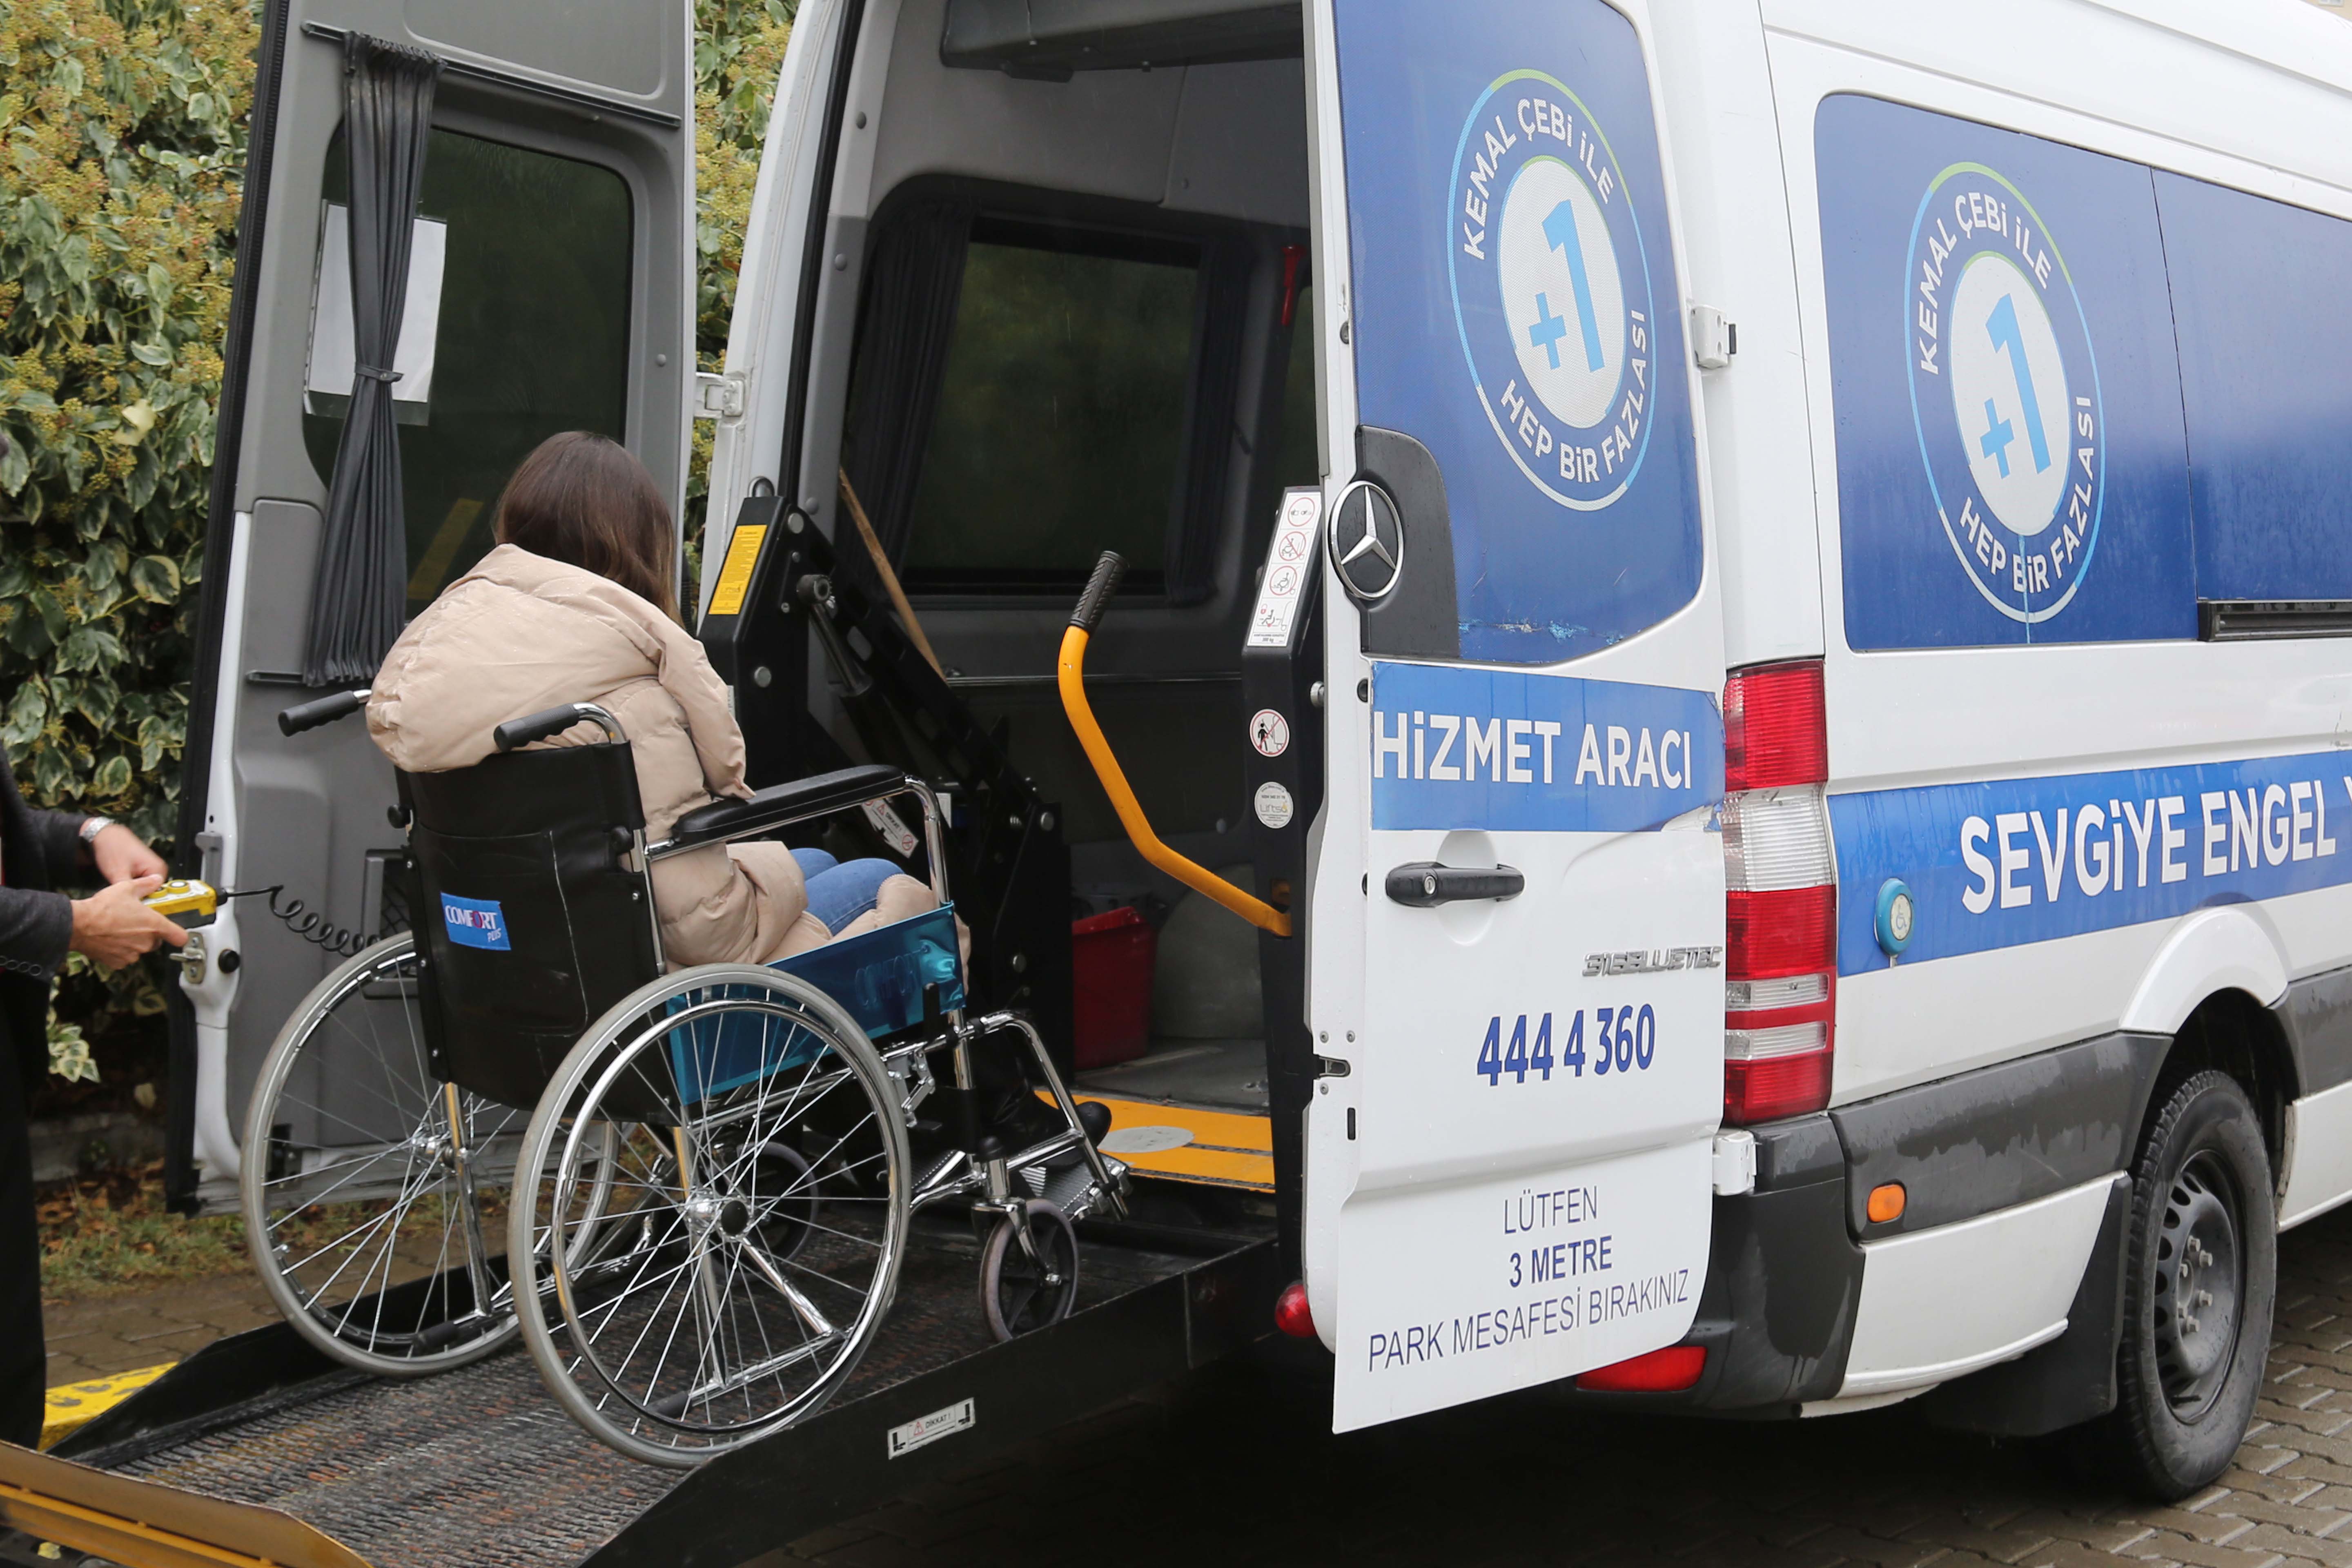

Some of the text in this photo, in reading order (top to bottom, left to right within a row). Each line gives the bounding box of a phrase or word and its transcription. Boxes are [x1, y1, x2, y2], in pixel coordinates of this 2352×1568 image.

[1464, 115, 1517, 260] KEMAL
[1919, 218, 1957, 375] KEMAL
[1501, 379, 1552, 458] HEP
[1601, 310, 1646, 475] FAZLASI
[1960, 497, 2006, 575] HEP
[2050, 396, 2094, 579] FAZLASI
[1575, 724, 1691, 789] ARACI
[2200, 779, 2336, 877] ENGEL
[445, 905, 498, 929] COMFORT
[1477, 1003, 1655, 1087] 444 4 360
[1503, 1185, 1598, 1235] LÜTFEN
[1509, 1235, 1612, 1288] 3 METRE
[1368, 1321, 1445, 1372] PARK
[1589, 1268, 1690, 1325] BIRAKINIZ
